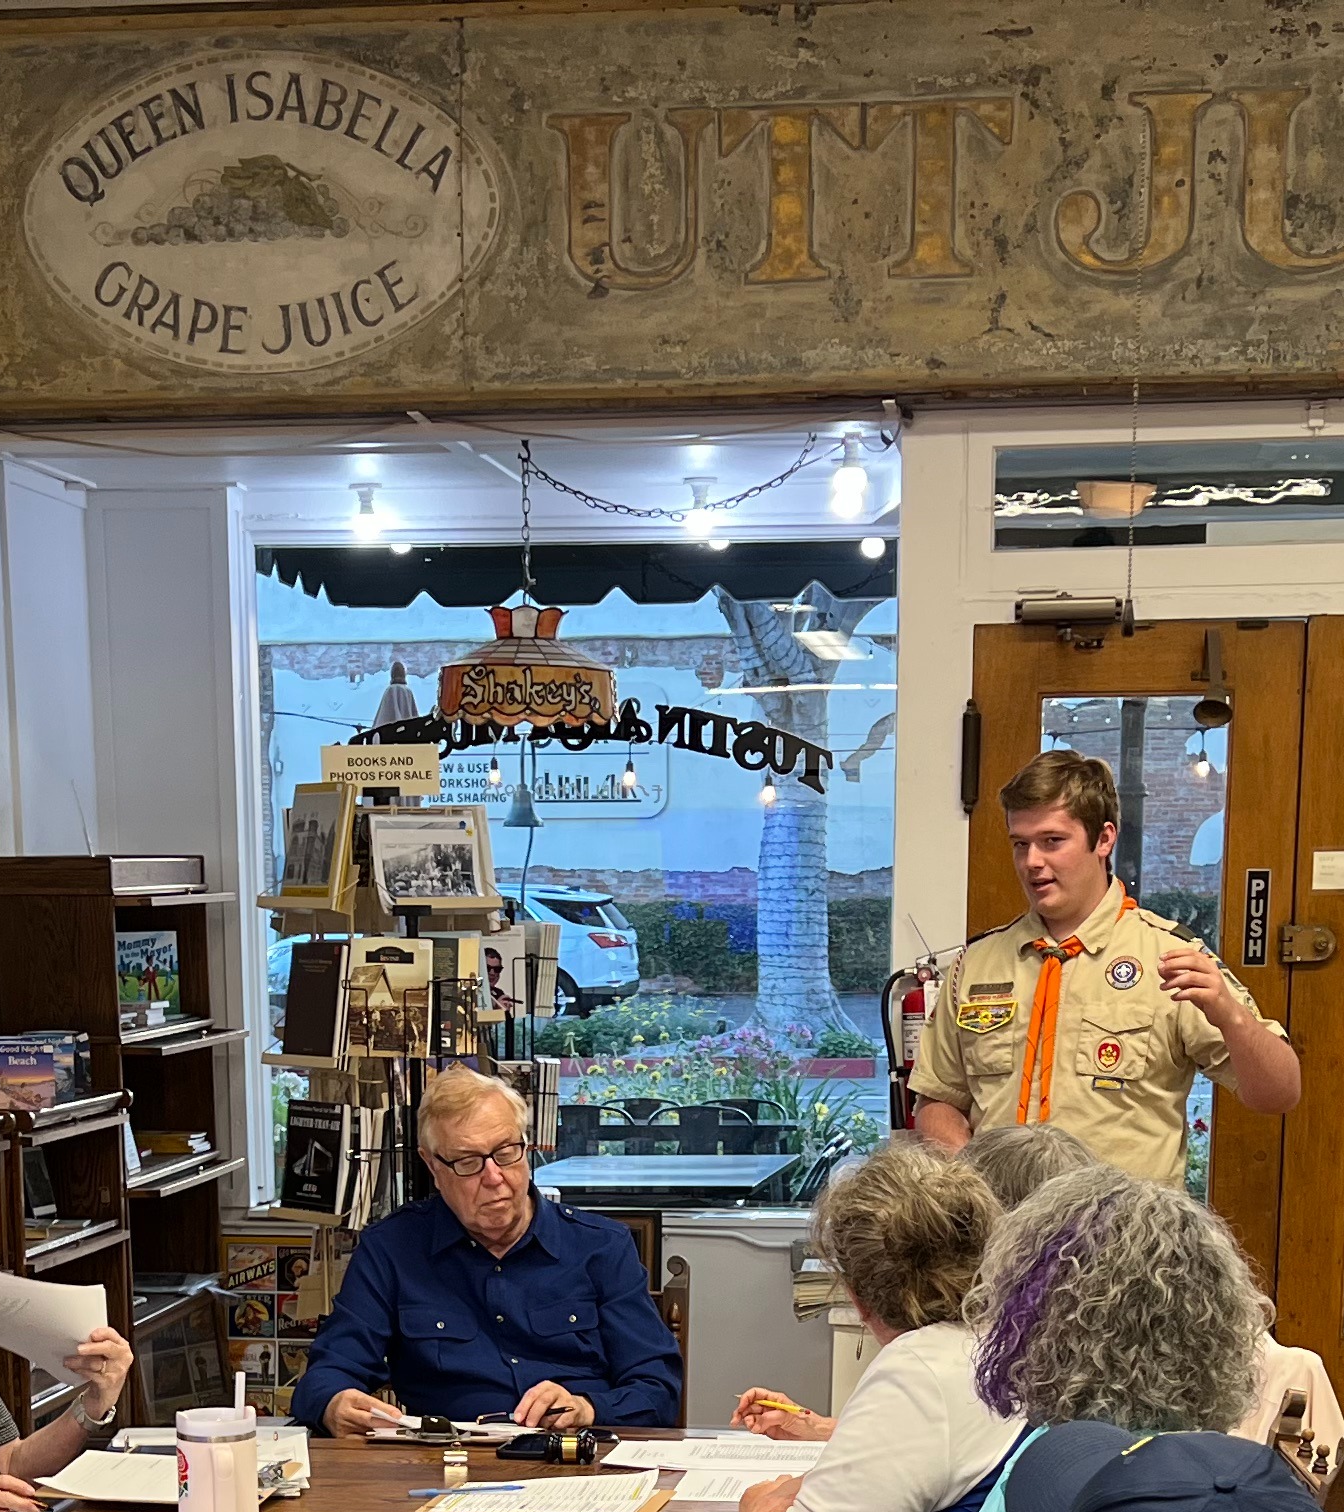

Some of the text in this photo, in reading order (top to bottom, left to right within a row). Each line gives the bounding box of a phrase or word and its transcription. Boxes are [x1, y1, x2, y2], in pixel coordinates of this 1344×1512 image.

[59, 69, 453, 207] QUEEN ISABELLA
[544, 95, 1016, 290] UTT
[94, 259, 418, 355] GRAPE JUICE
[347, 755, 413, 767] BOOKS AND
[329, 769, 434, 782] PHOTOS FOR SALE
[457, 792, 507, 803] SHARING
[1247, 878, 1266, 958] PUSH
[140, 944, 172, 961] Mayor
[0, 1045, 20, 1053] Good
[8, 1056, 37, 1066] Beach
[228, 1260, 276, 1288] AIRWAYS
